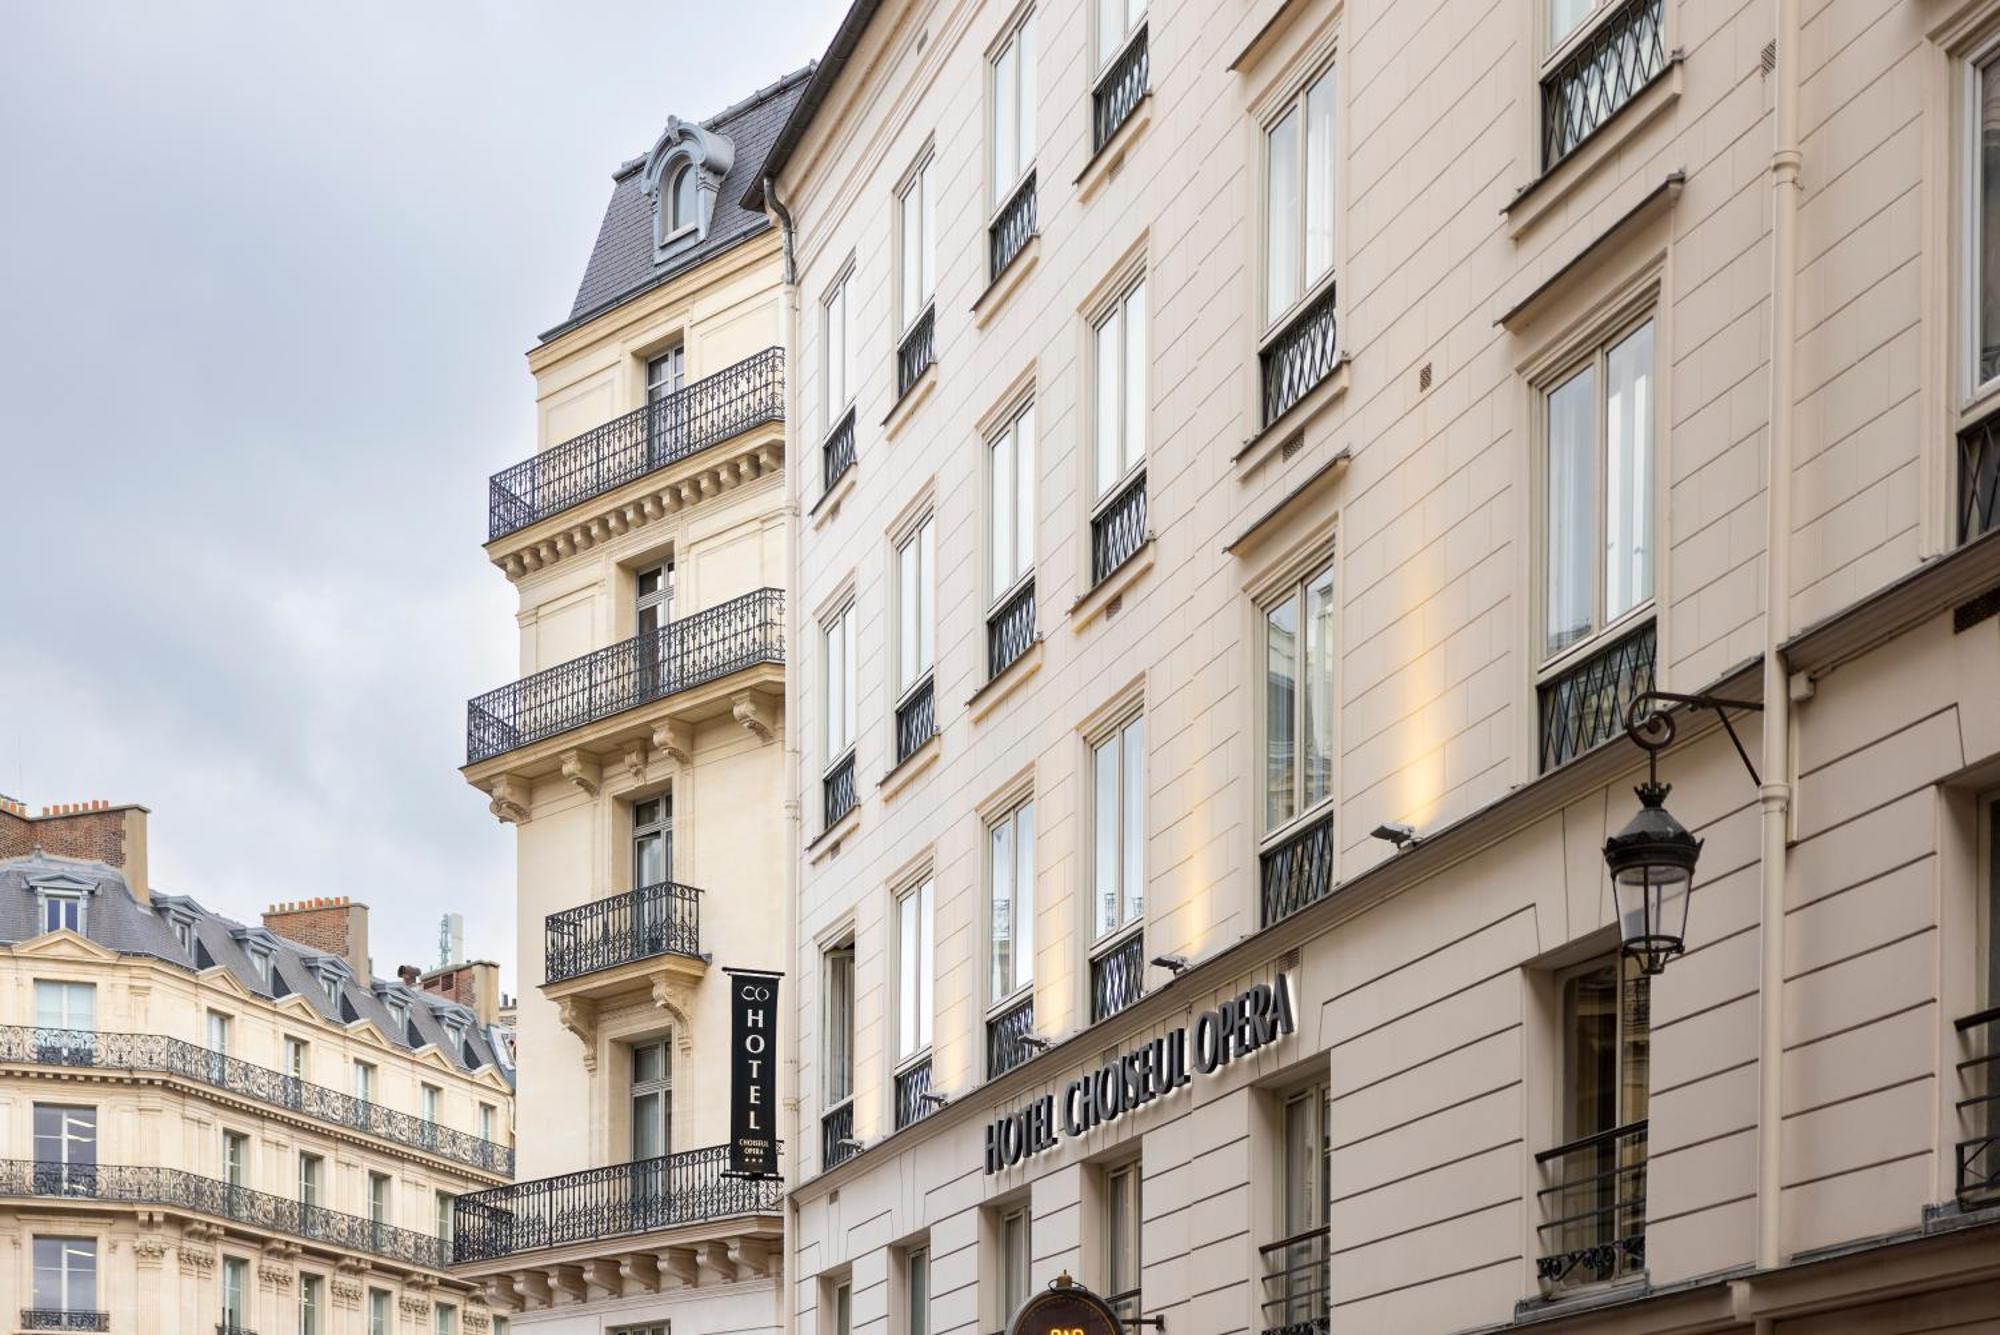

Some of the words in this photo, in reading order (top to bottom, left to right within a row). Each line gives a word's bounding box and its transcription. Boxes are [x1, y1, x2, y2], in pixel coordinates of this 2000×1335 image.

[745, 1009, 765, 1130] HOTEL
[985, 1094, 1058, 1176] HOTEL
[1062, 1027, 1191, 1137] CHOISEUL
[1194, 972, 1295, 1074] OPERA
